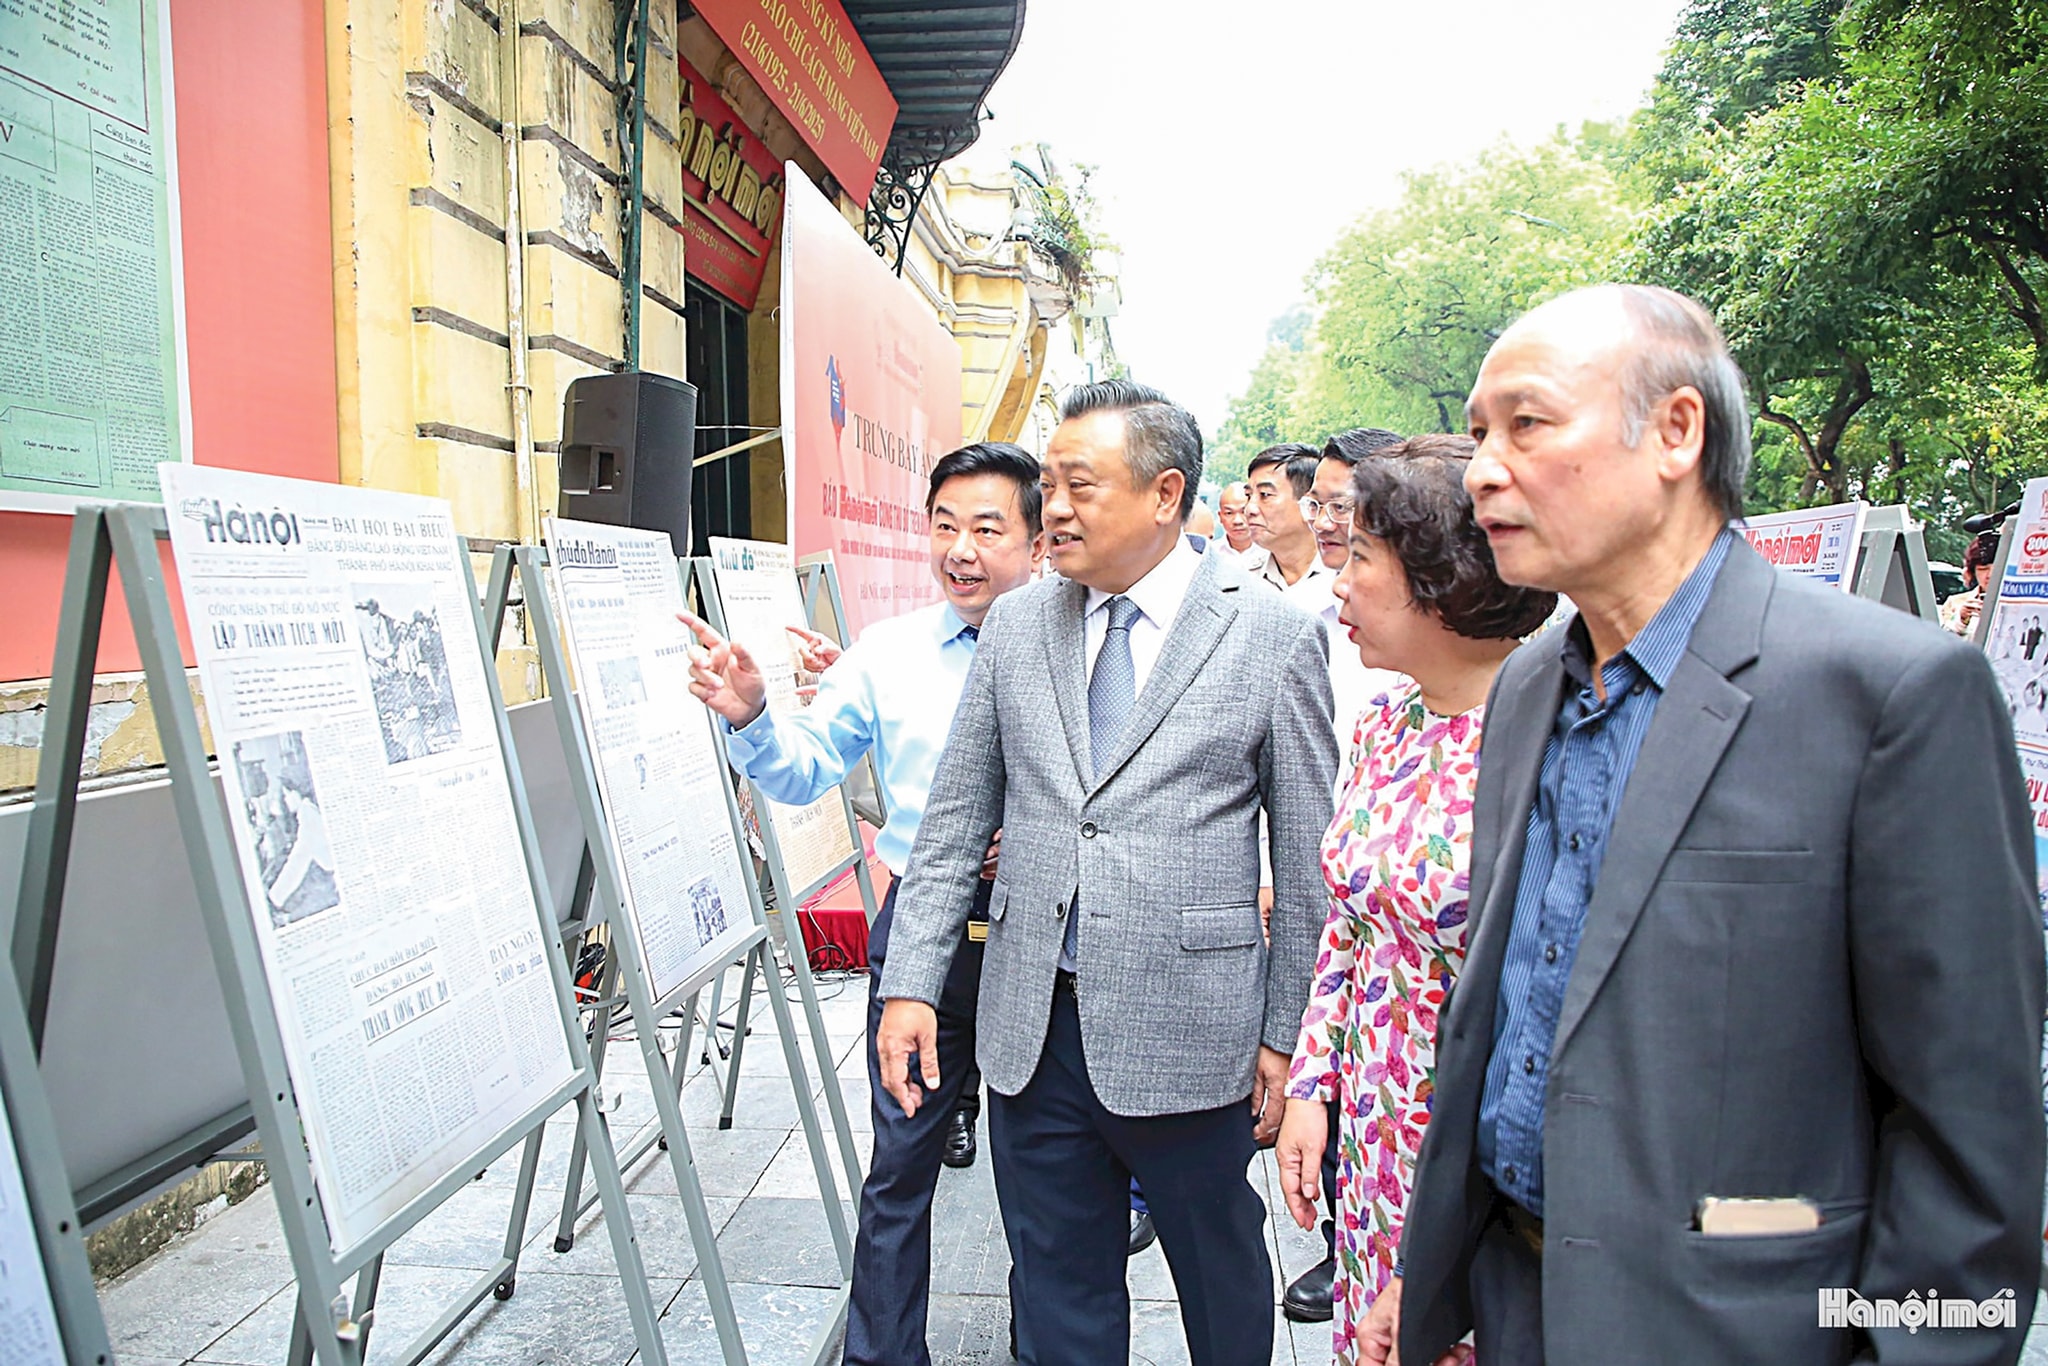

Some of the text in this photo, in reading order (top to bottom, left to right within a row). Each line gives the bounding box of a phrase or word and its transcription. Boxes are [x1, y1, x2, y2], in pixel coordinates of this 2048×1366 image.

[740, 20, 788, 91] (21/6/1925
[788, 82, 826, 144] 21/6/2025)
[832, 33, 856, 79] NIỆM
[784, 17, 808, 57] CHÍ
[801, 43, 828, 93] CÁCH
[823, 75, 850, 122] MẠNG
[846, 107, 865, 143] VIỆT
[860, 129, 880, 163] NAM
[854, 413, 895, 465] TRƯNG
[898, 431, 918, 474] BÀY
[362, 519, 388, 537] HỘI
